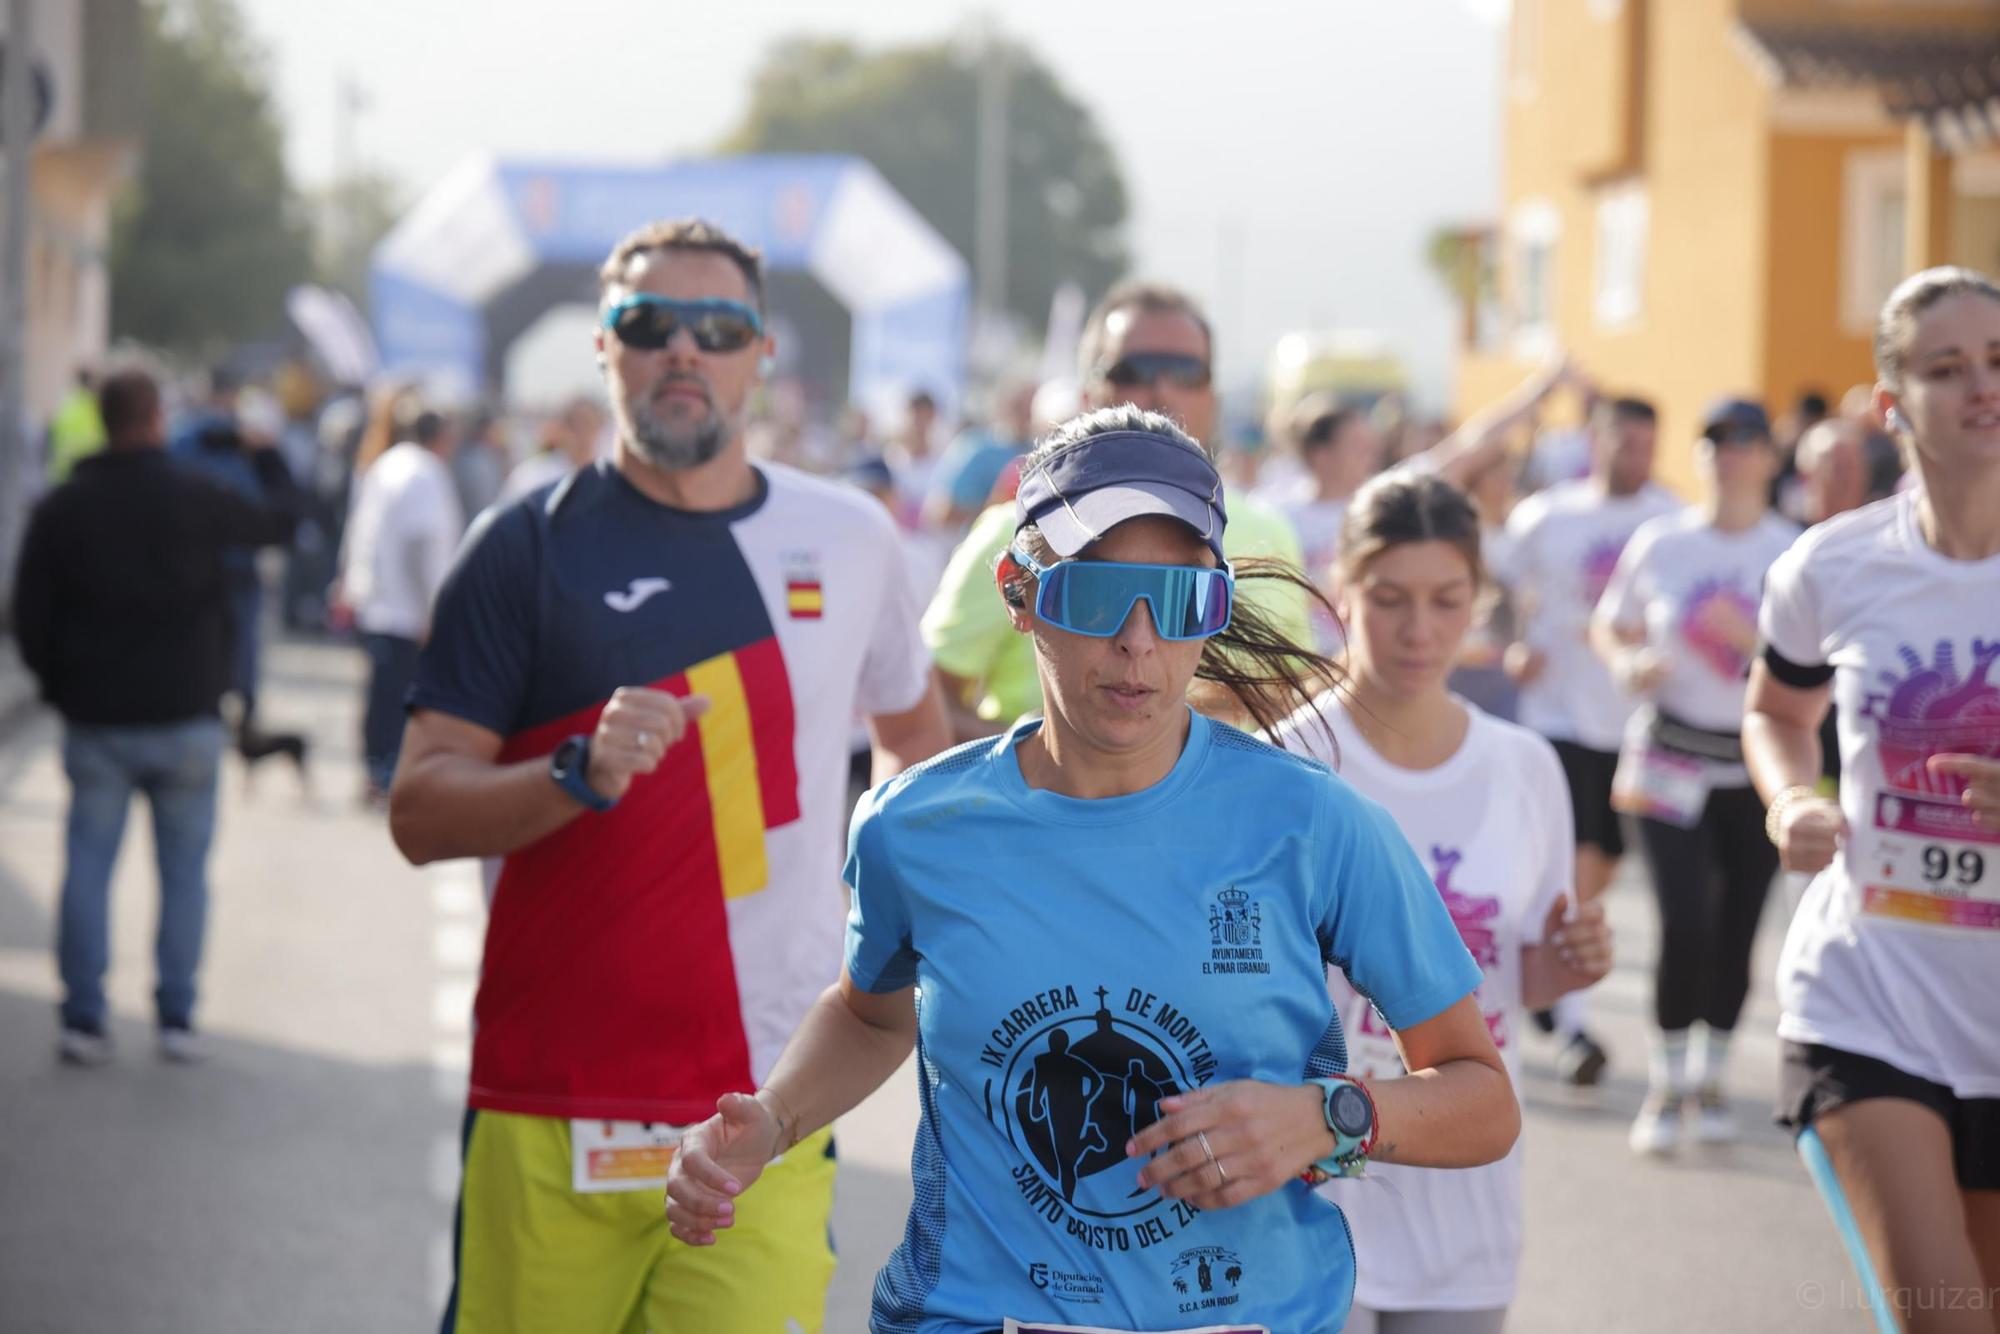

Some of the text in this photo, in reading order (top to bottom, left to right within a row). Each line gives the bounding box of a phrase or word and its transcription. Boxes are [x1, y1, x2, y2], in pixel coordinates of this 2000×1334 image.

[1923, 845, 1984, 884] 99
[1211, 948, 1263, 960] AYUNTAMIENTO
[1202, 963, 1212, 974] EL
[1213, 963, 1236, 974] PINAR
[1125, 987, 1158, 1019] DE
[991, 984, 1080, 1050] CARRERA
[980, 1043, 1007, 1069] IX
[1012, 1162, 1201, 1253] SANTO CRISTO DEL ZA
[1052, 1270, 1104, 1283] Diputación
[1052, 1282, 1105, 1294] de Granada
[1200, 1298, 1216, 1310] SAN
